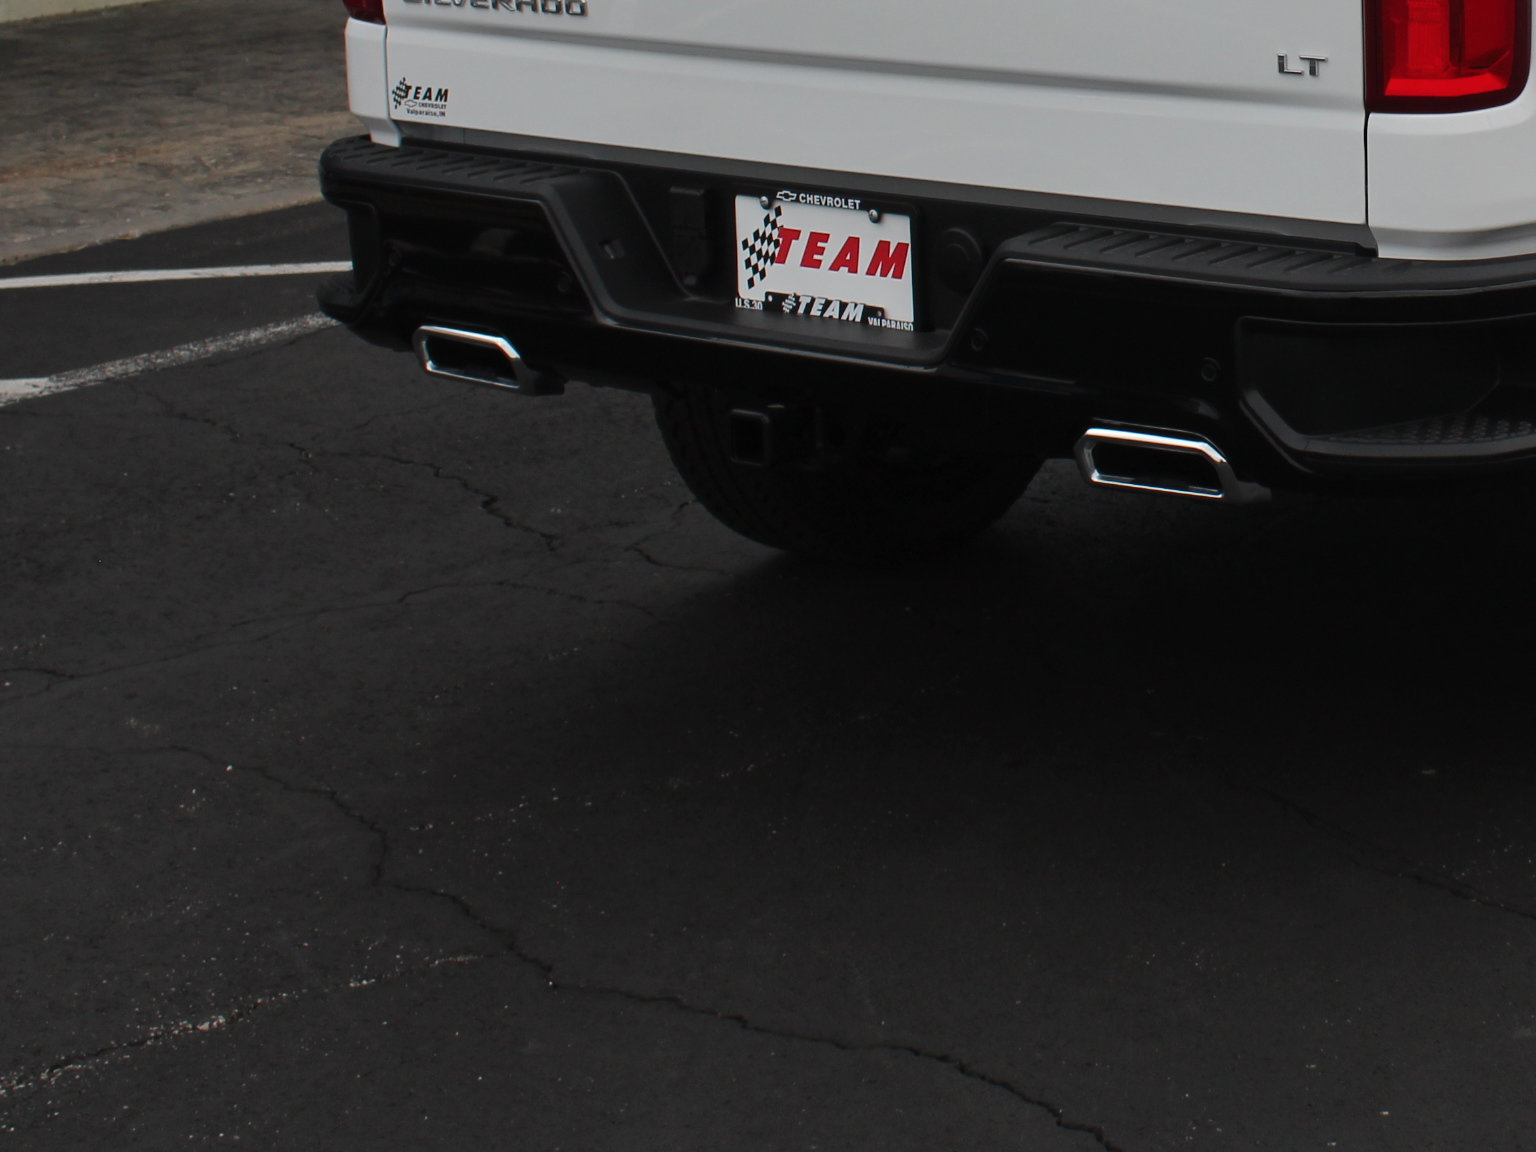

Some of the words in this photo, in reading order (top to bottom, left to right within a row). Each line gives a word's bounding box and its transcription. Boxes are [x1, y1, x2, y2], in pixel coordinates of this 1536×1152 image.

[1277, 53, 1328, 77] LT
[404, 85, 449, 102] TEAM
[799, 193, 861, 210] CHEVROLET
[775, 228, 909, 280] TEAM
[797, 295, 865, 322] TEAM
